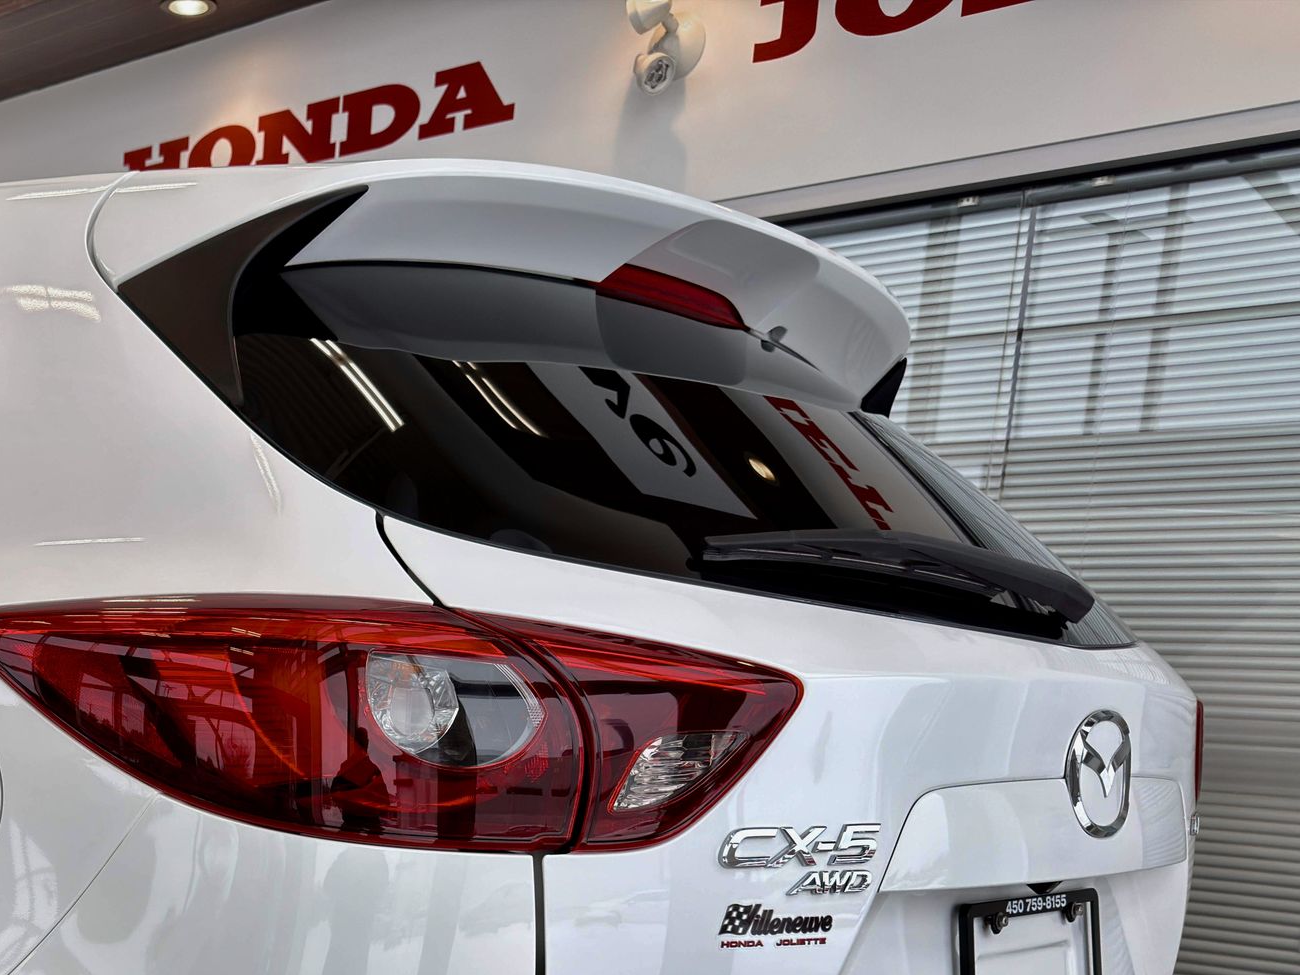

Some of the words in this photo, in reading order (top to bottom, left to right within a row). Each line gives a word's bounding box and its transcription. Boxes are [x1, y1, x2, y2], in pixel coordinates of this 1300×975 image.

[123, 61, 515, 172] HONDA
[718, 823, 881, 868] CX-5
[786, 870, 873, 896] AWD
[1006, 900, 1024, 914] 450
[1026, 895, 1067, 912] 759-8155
[721, 940, 764, 948] HONDA
[776, 937, 826, 947] JOLIETTE
